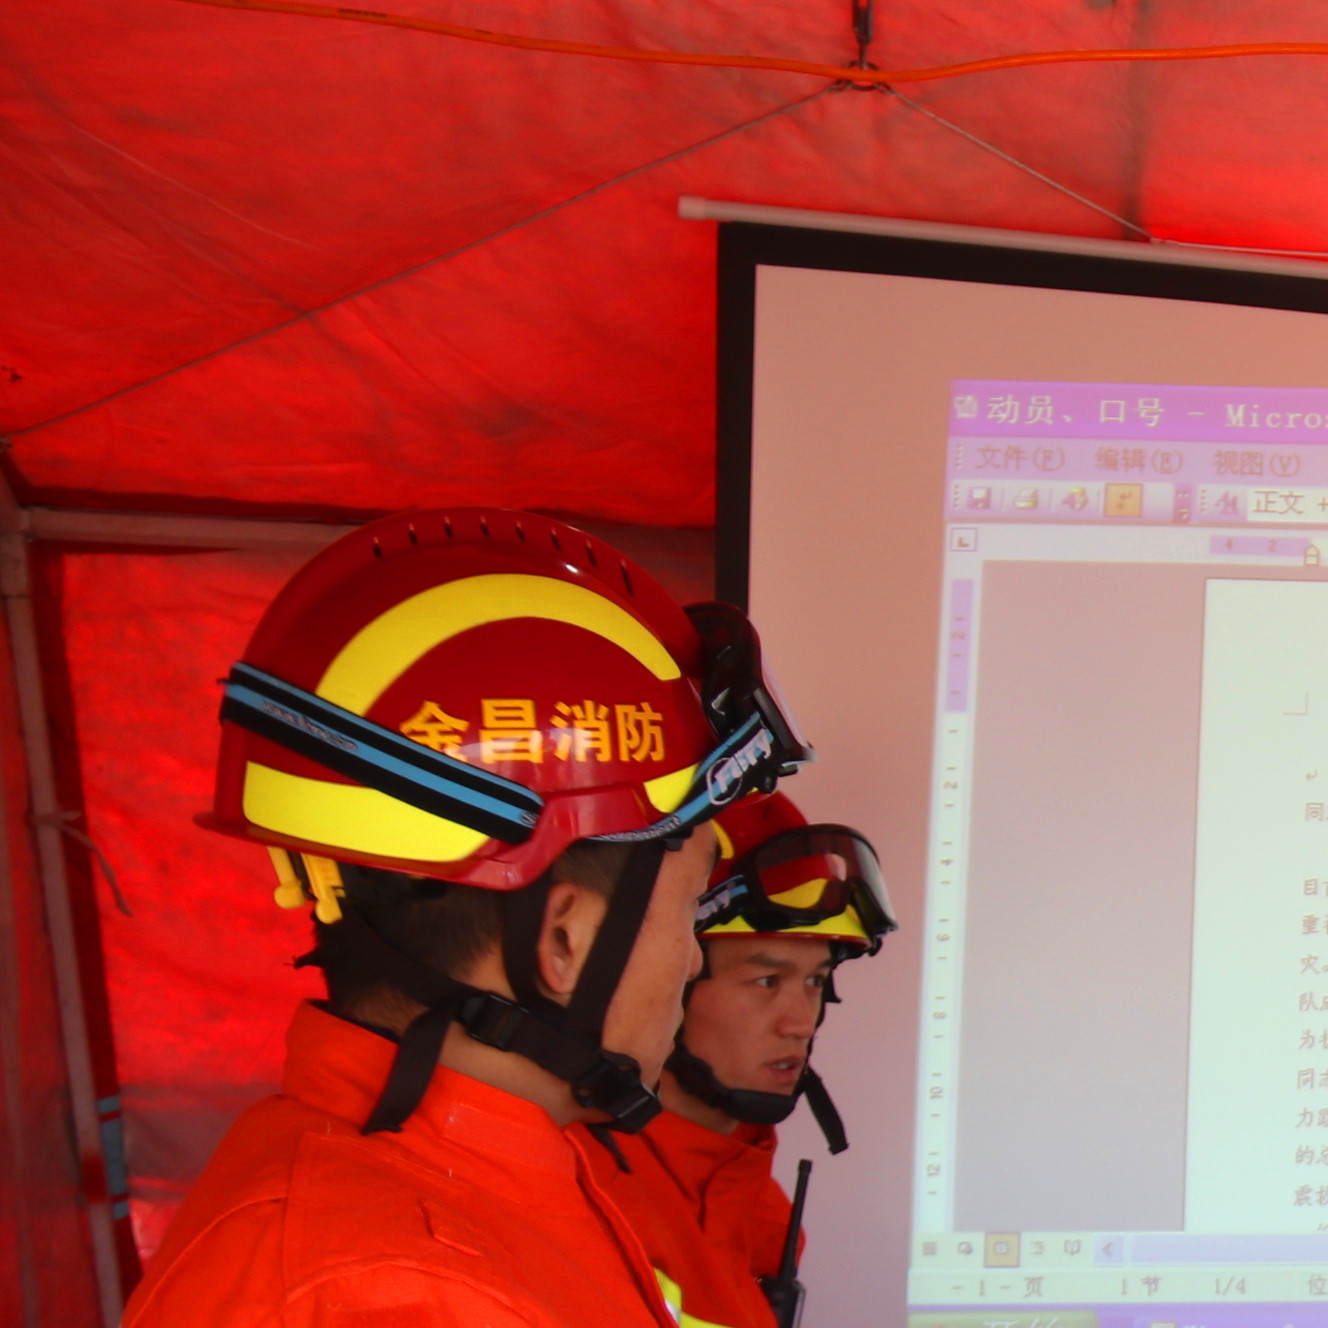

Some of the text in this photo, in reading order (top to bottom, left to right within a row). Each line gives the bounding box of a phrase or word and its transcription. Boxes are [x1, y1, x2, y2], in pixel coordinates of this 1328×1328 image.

[986, 393, 1164, 429] 动员、口号
[976, 446, 1065, 473] 文件(F)
[1094, 447, 1183, 476] 编辑(E)
[1213, 449, 1301, 478] 视图(V)
[1252, 490, 1305, 516] 正文
[400, 697, 666, 765] 金昌消防
[1023, 1276, 1044, 1299] 页
[1141, 1275, 1162, 1296] 节
[1213, 1277, 1249, 1297] 1/4
